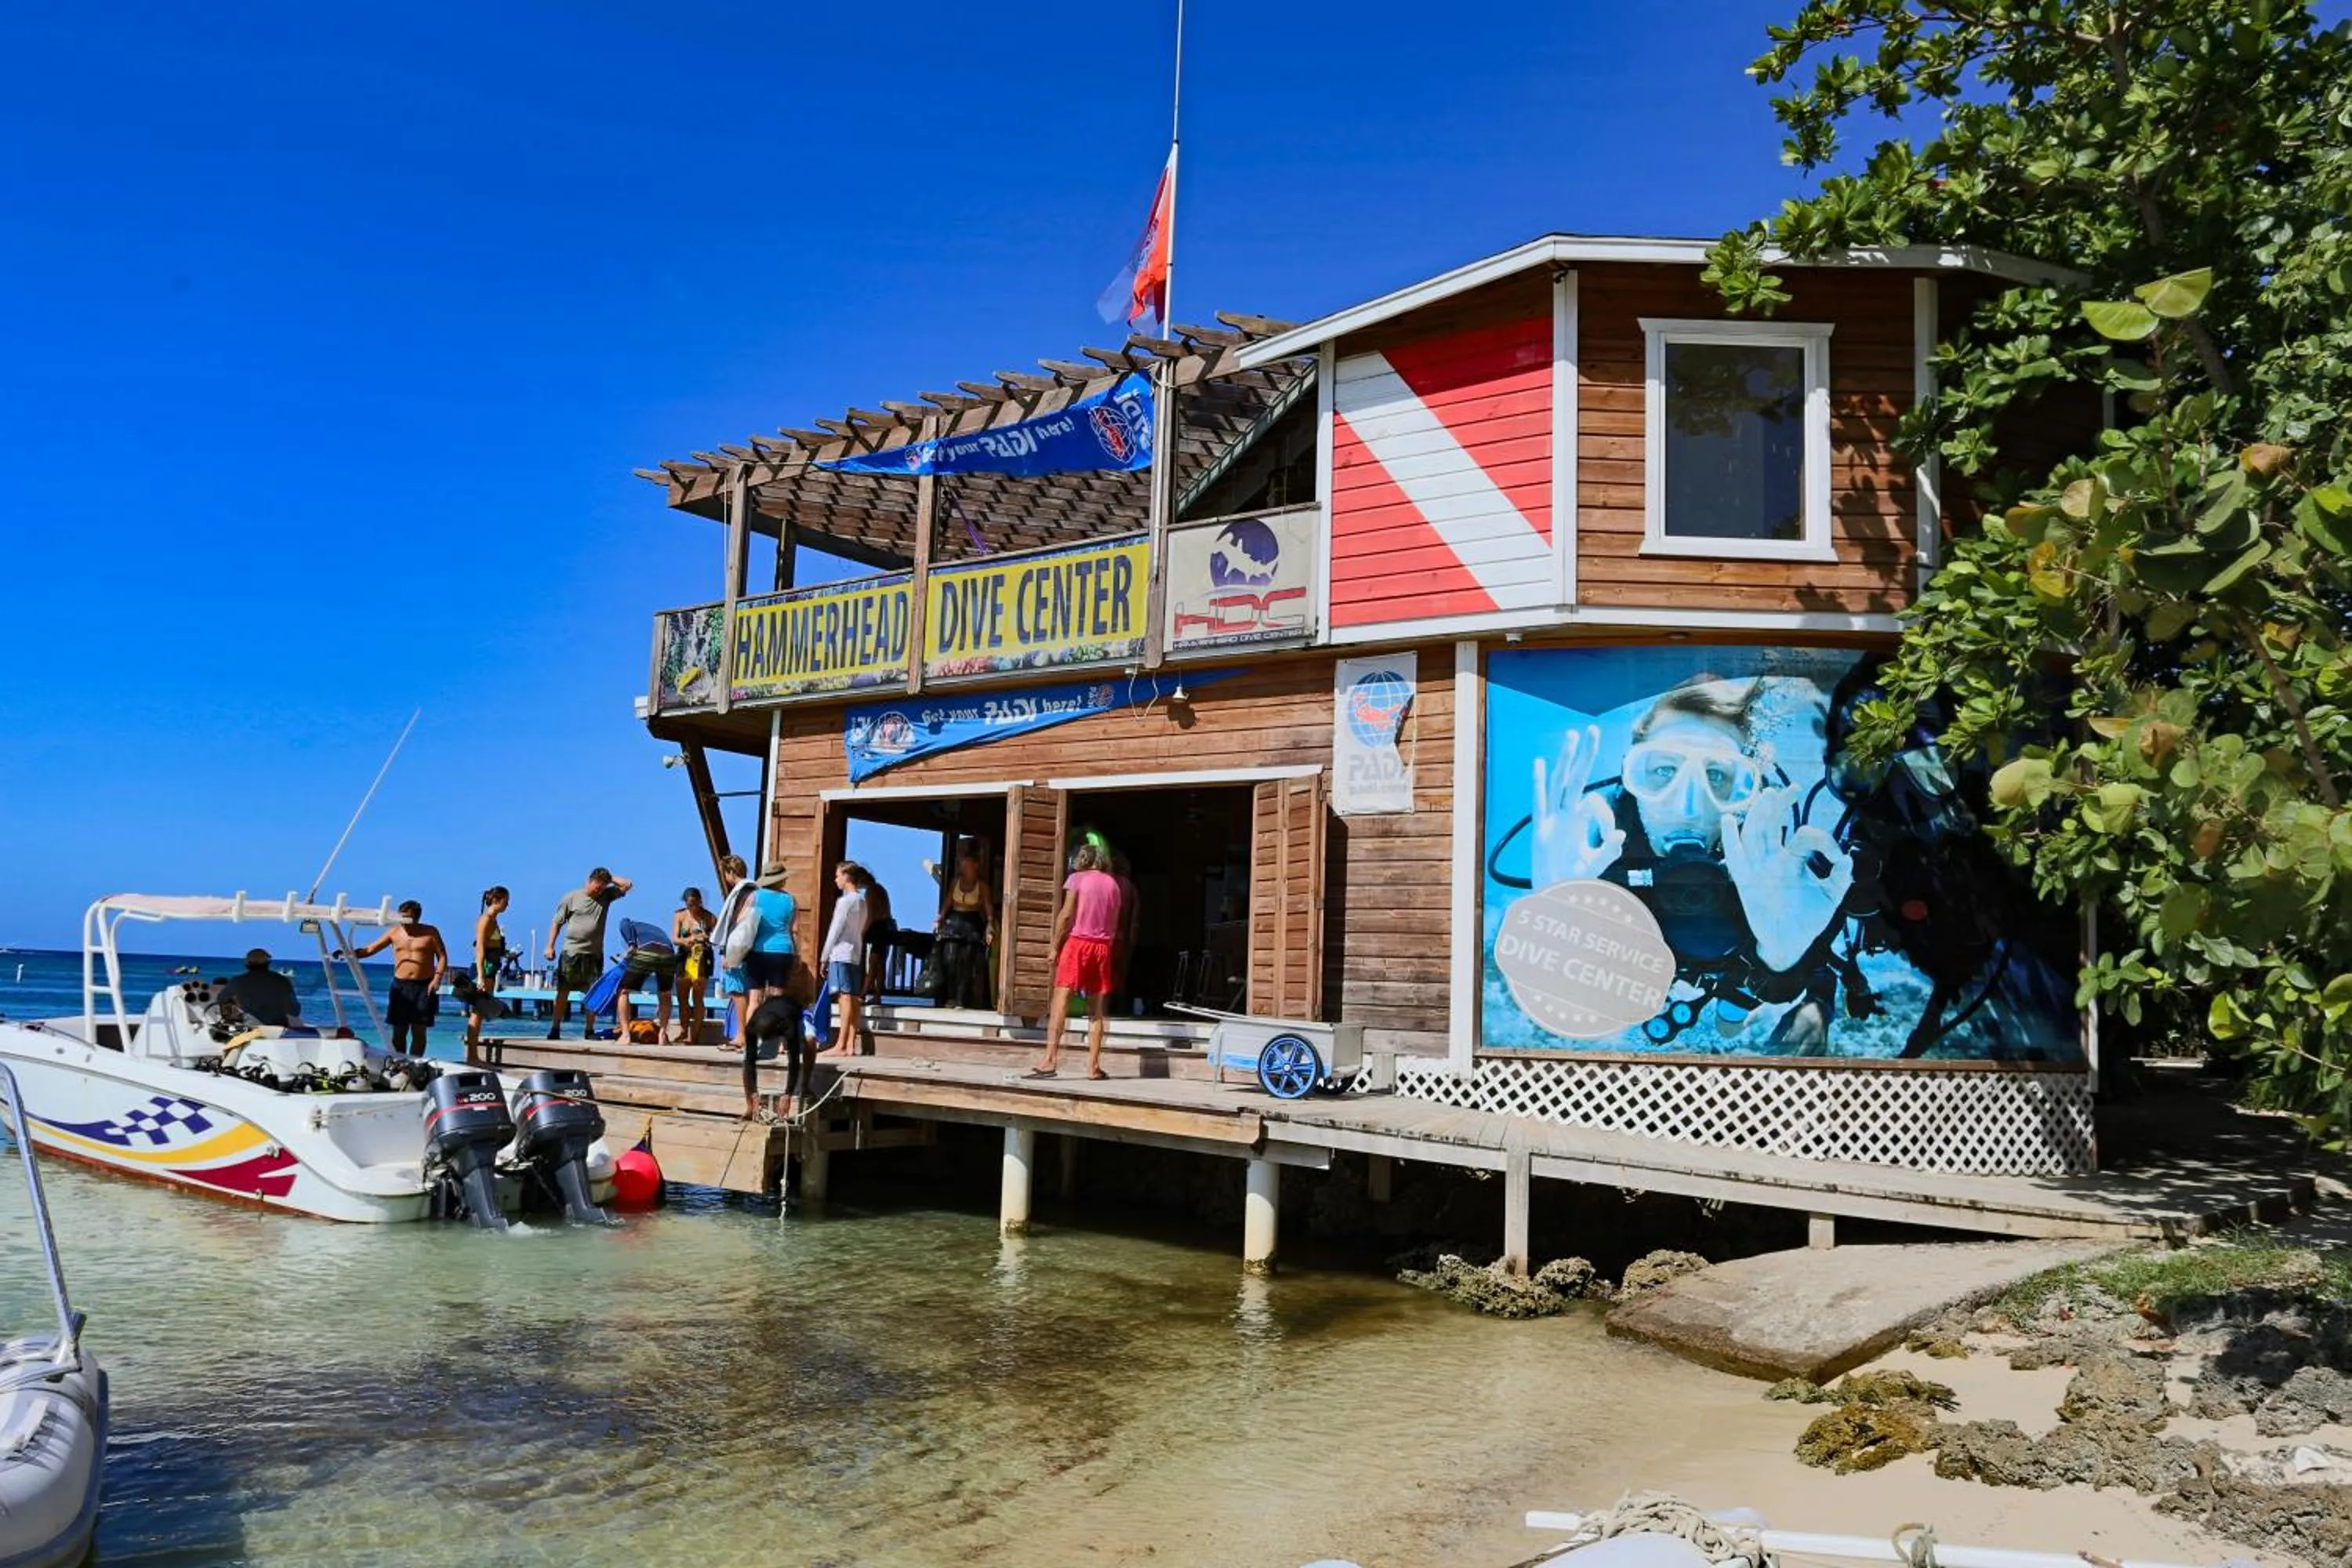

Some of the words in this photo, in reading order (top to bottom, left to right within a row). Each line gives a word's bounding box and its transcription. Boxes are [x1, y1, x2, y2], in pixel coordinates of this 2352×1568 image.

[978, 427, 1038, 457] PADI
[733, 592, 909, 681] HAMMERHEAD
[939, 573, 1004, 654] DIVE
[1018, 555, 1132, 643] CENTER
[984, 697, 1037, 725] PADI
[1041, 695, 1082, 713] here!
[1348, 752, 1407, 780] PAD
[1517, 910, 1530, 924] 5
[1533, 915, 1581, 943] STAR
[1583, 931, 1664, 974] SERVICE
[1501, 934, 1560, 971] DIVE
[1563, 957, 1662, 1010] CENTER
[469, 1093, 495, 1102] 200
[564, 1089, 587, 1098] 200
